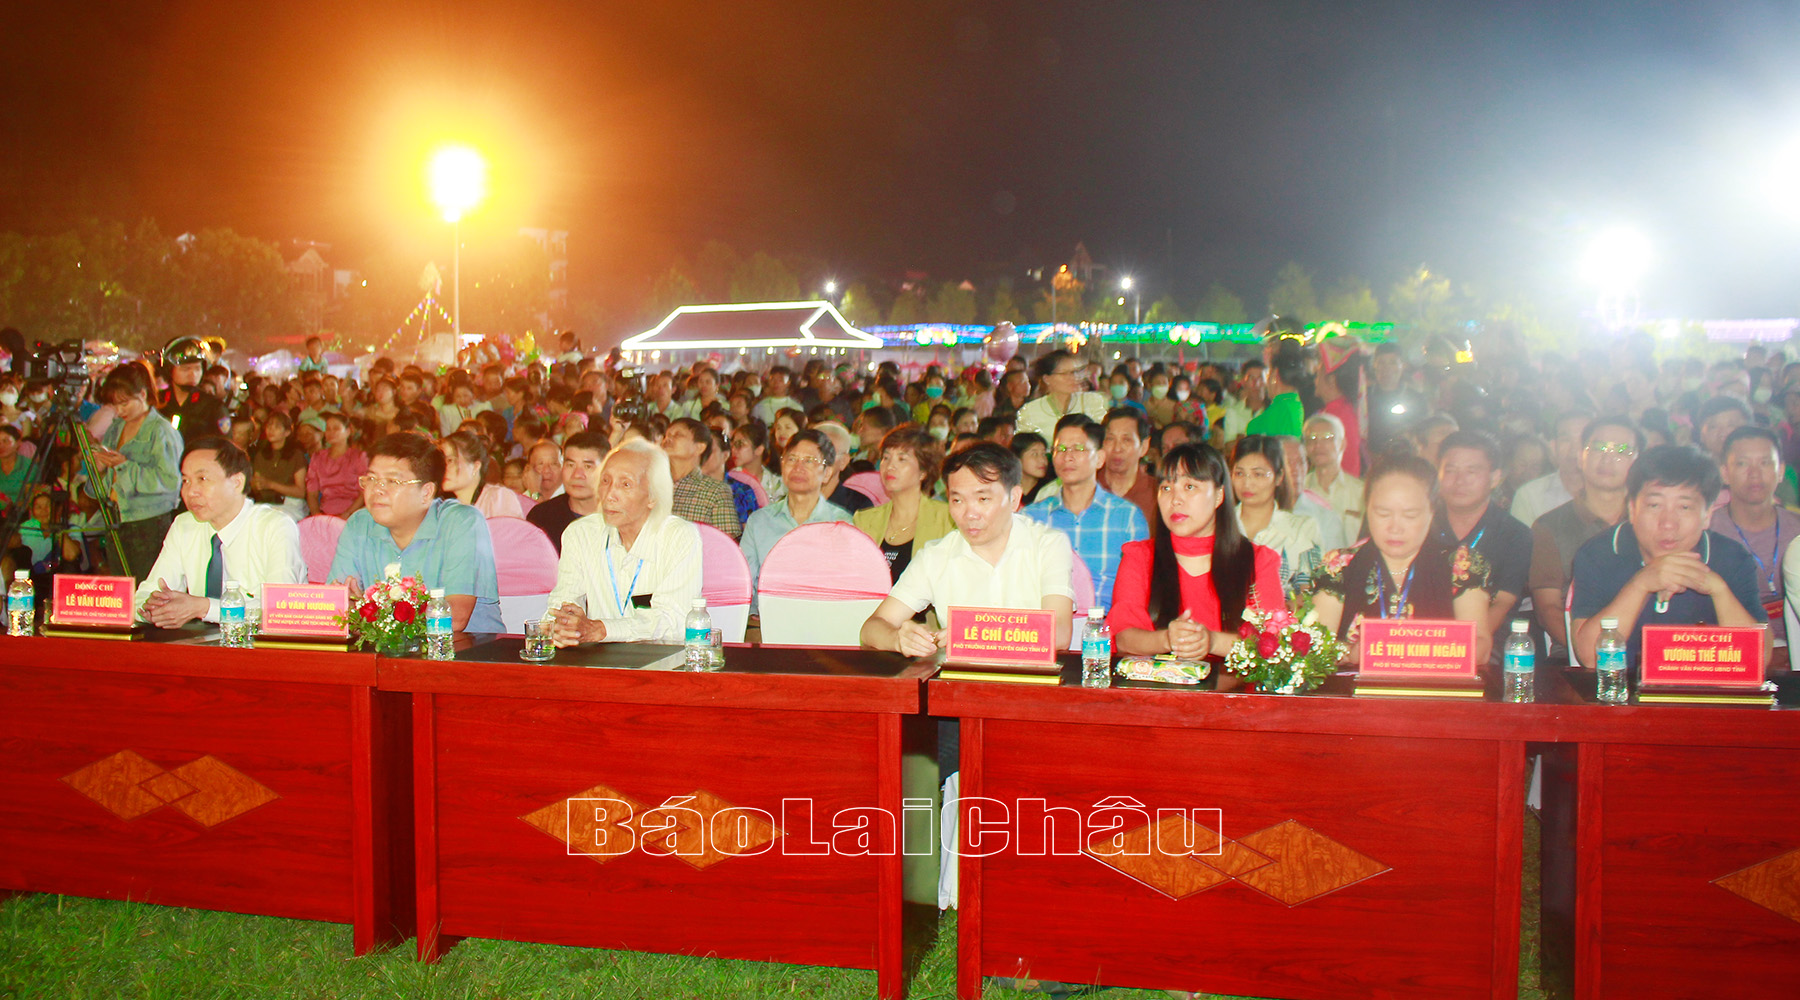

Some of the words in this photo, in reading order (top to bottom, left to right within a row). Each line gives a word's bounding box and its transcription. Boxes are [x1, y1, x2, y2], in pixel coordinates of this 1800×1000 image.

[66, 594, 75, 606] LÊ
[77, 595, 94, 607] VĂN
[95, 596, 122, 608] LƯƠNG
[288, 601, 305, 609] VĂN
[1008, 615, 1028, 624] CHÍ
[964, 626, 978, 640] LÊ
[981, 627, 1002, 641] CHÍ
[1005, 628, 1038, 643] CÔNG
[1425, 628, 1446, 637] CHÍ
[1710, 633, 1733, 642] CHÍ
[1370, 641, 1383, 655] LÊ
[1386, 643, 1404, 659] THỊ
[1407, 644, 1430, 656] KIM
[1433, 643, 1466, 657] NGÂN
[1663, 648, 1696, 661] VƯƠNG
[1698, 646, 1717, 662] THẾ
